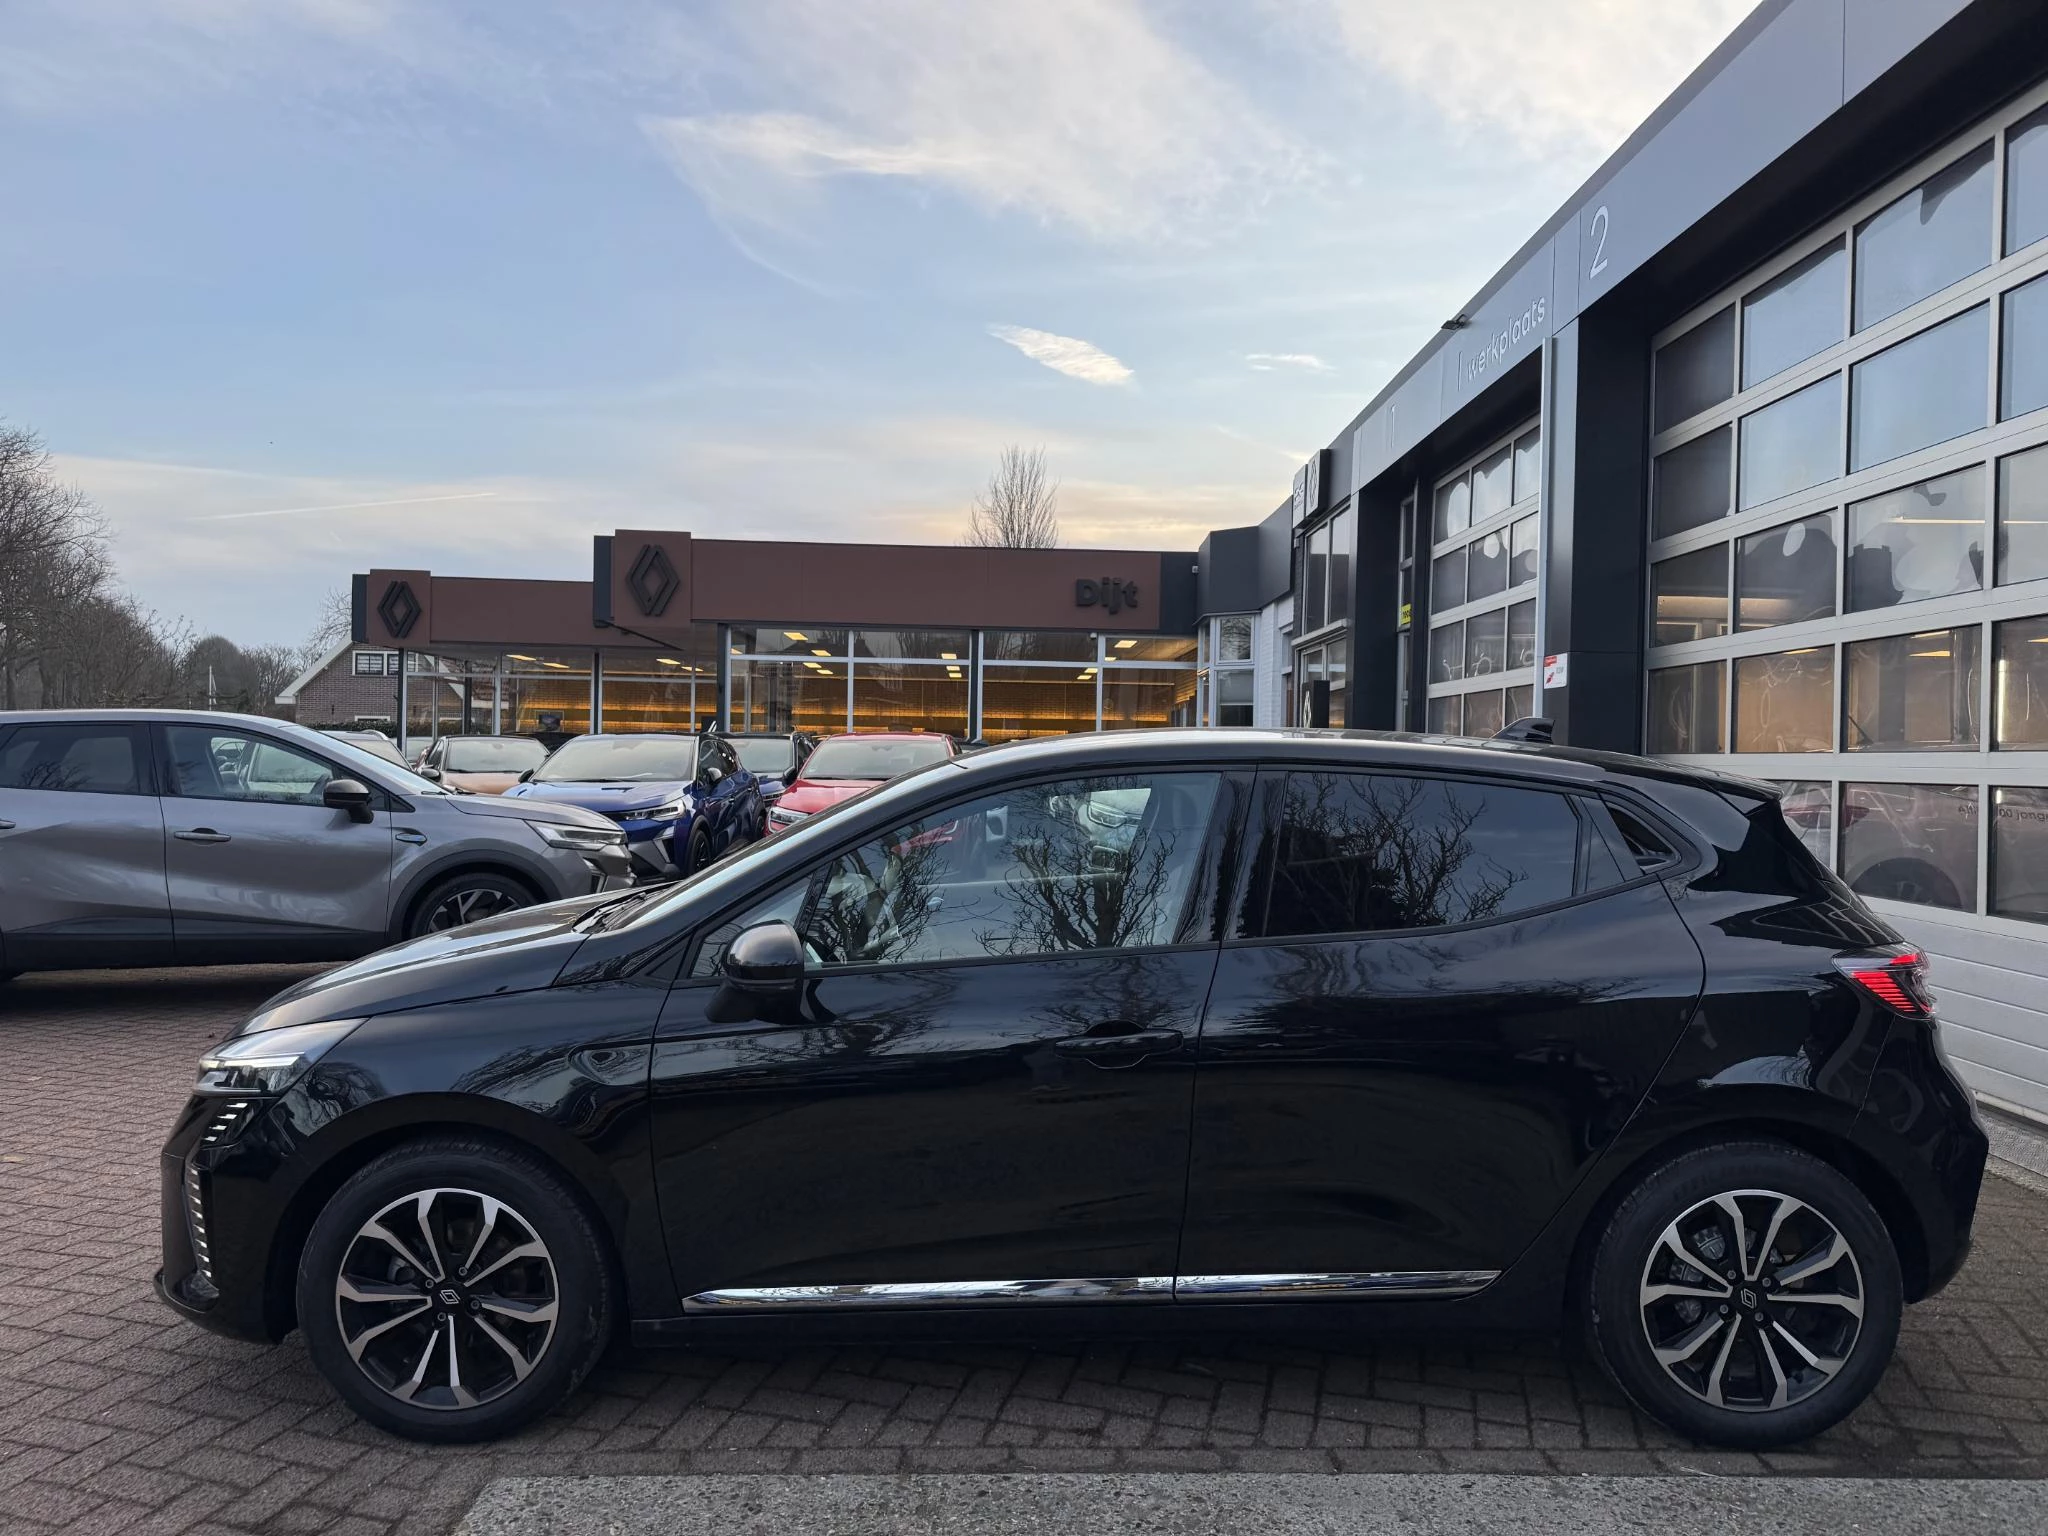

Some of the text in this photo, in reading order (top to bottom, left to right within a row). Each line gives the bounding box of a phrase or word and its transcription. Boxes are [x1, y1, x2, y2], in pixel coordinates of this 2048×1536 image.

[1589, 205, 1609, 280] 2
[1467, 296, 1545, 381] werkplaats
[1076, 577, 1138, 615] Dijt
